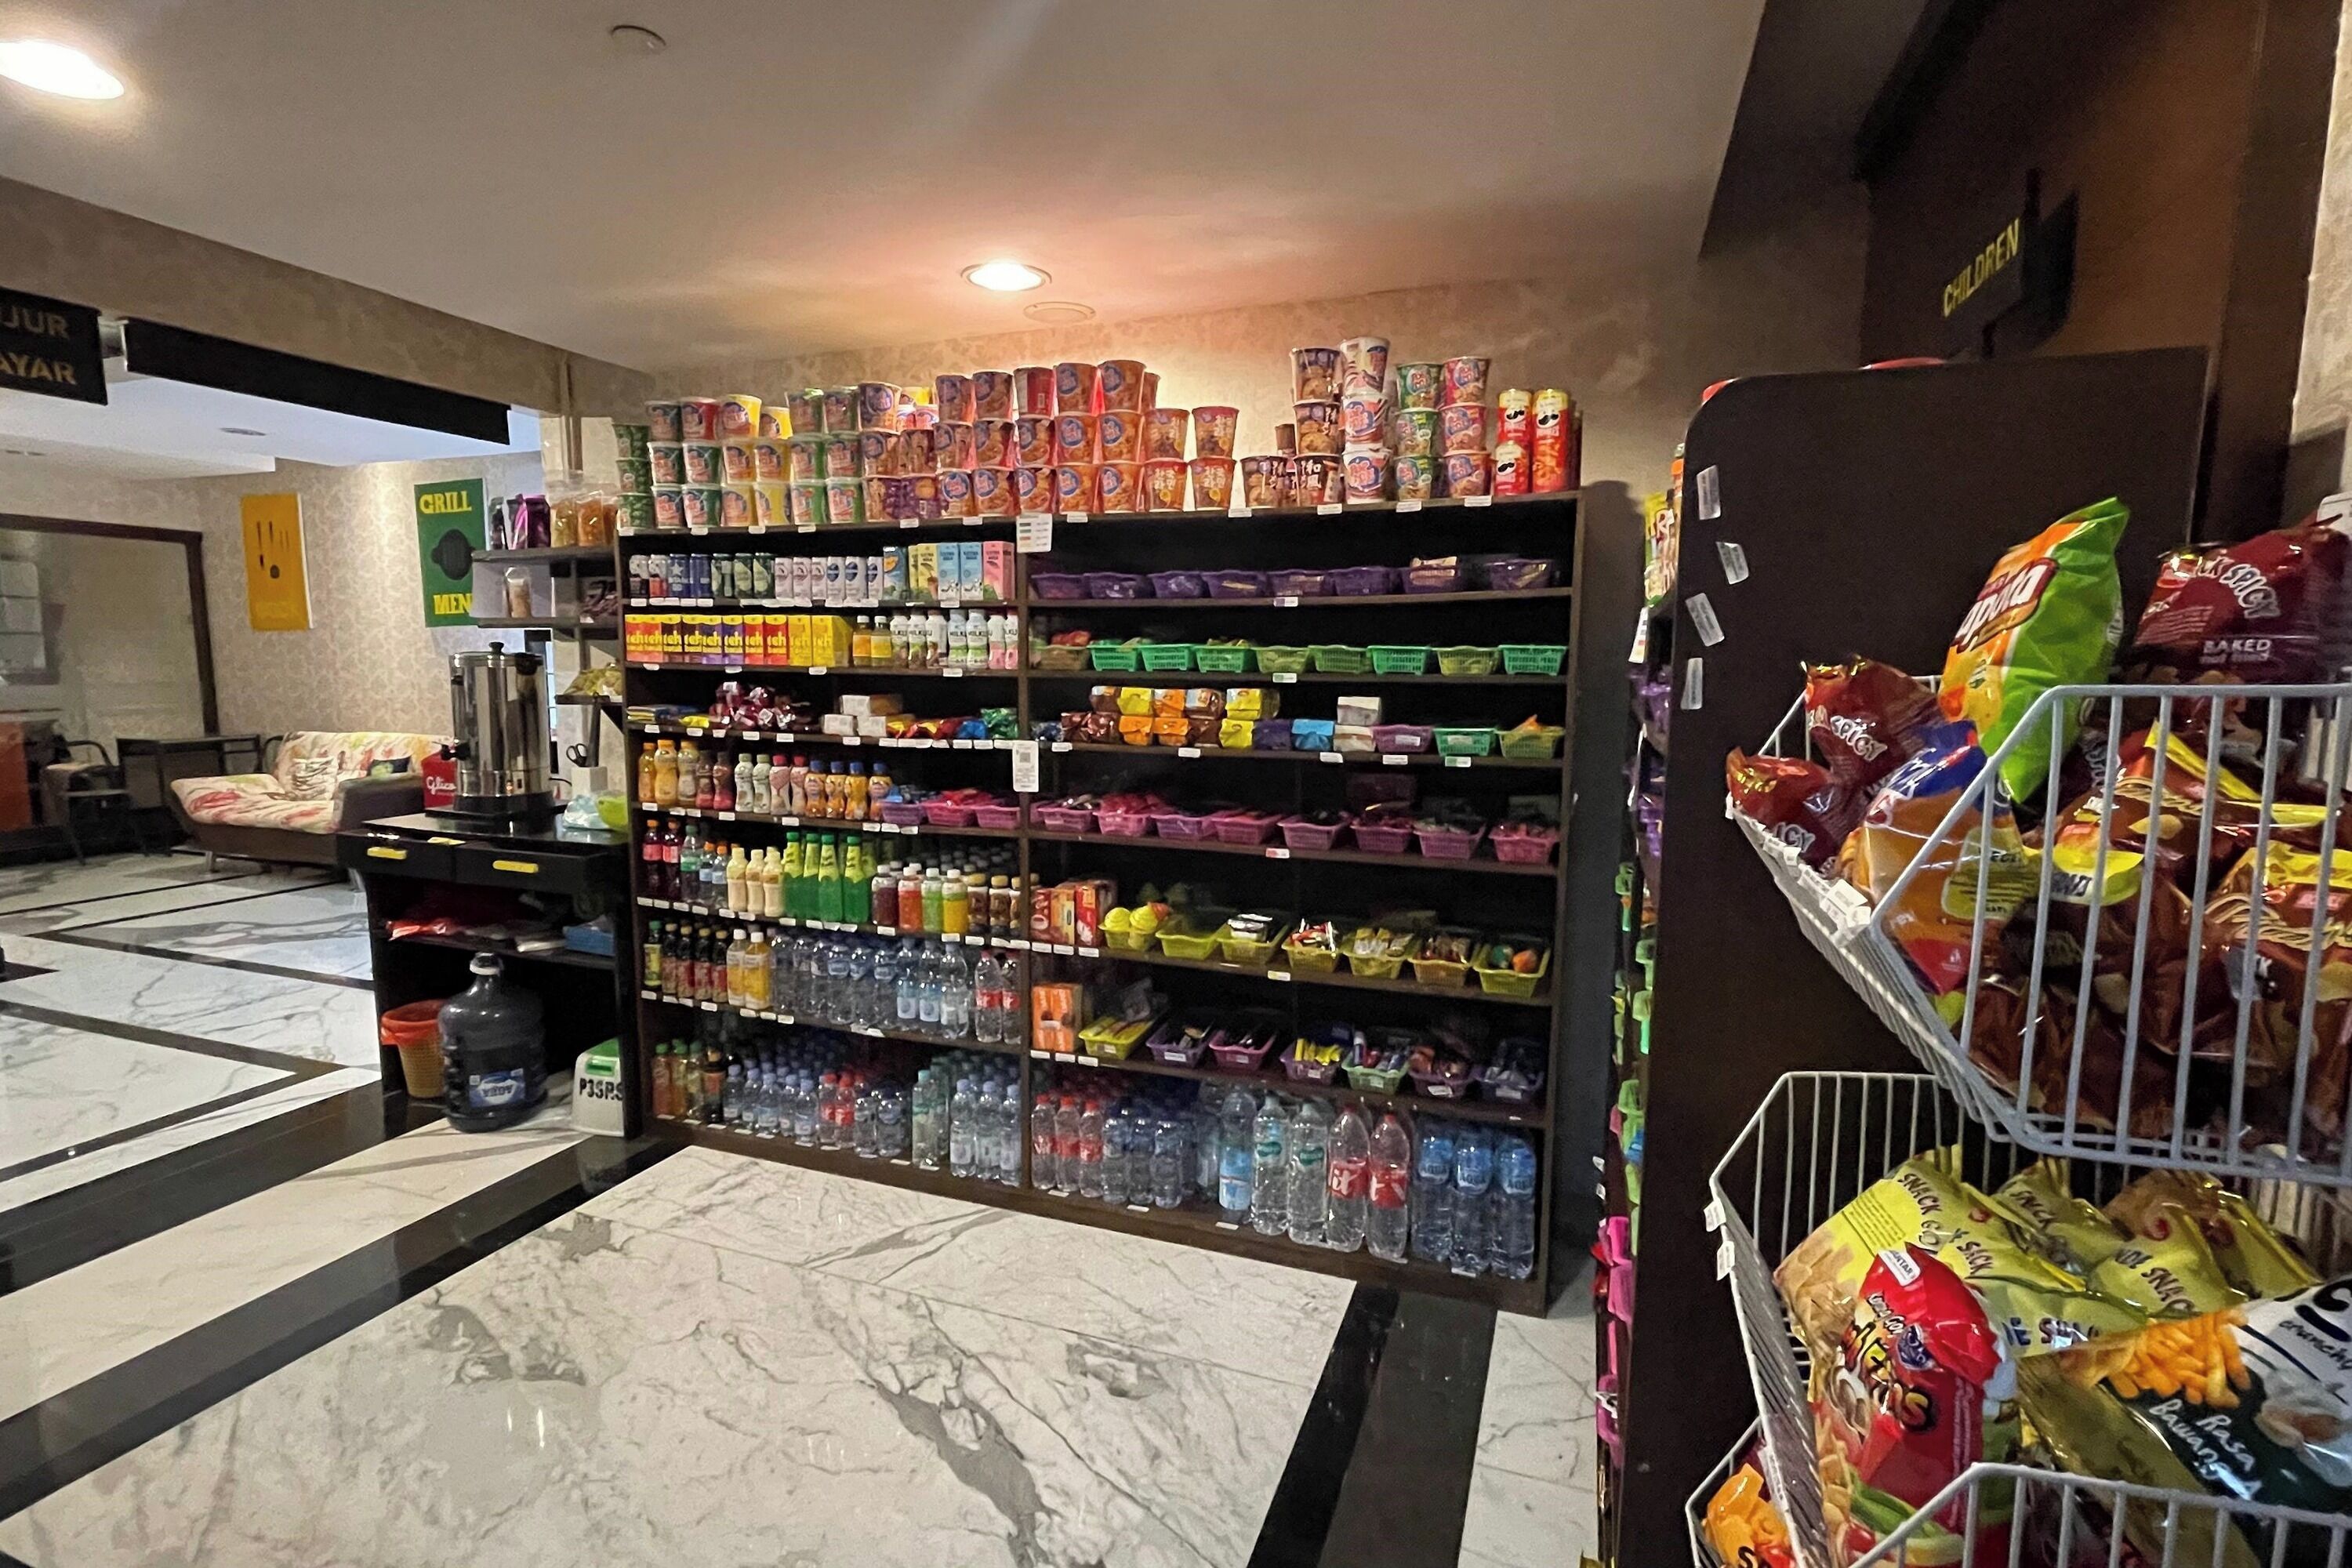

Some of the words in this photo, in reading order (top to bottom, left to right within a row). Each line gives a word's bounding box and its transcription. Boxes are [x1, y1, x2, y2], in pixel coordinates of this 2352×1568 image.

[1944, 217, 2019, 318] CHILDREN
[419, 491, 472, 514] GRILL
[2220, 564, 2281, 619] SPICY
[2203, 639, 2271, 653] BAKED
[1830, 715, 1888, 761] SPICY
[426, 776, 457, 795] Glico
[1897, 1173, 1942, 1215] SNACK
[2149, 1398, 2234, 1480] Bawang
[2196, 1414, 2255, 1472] Rasa
